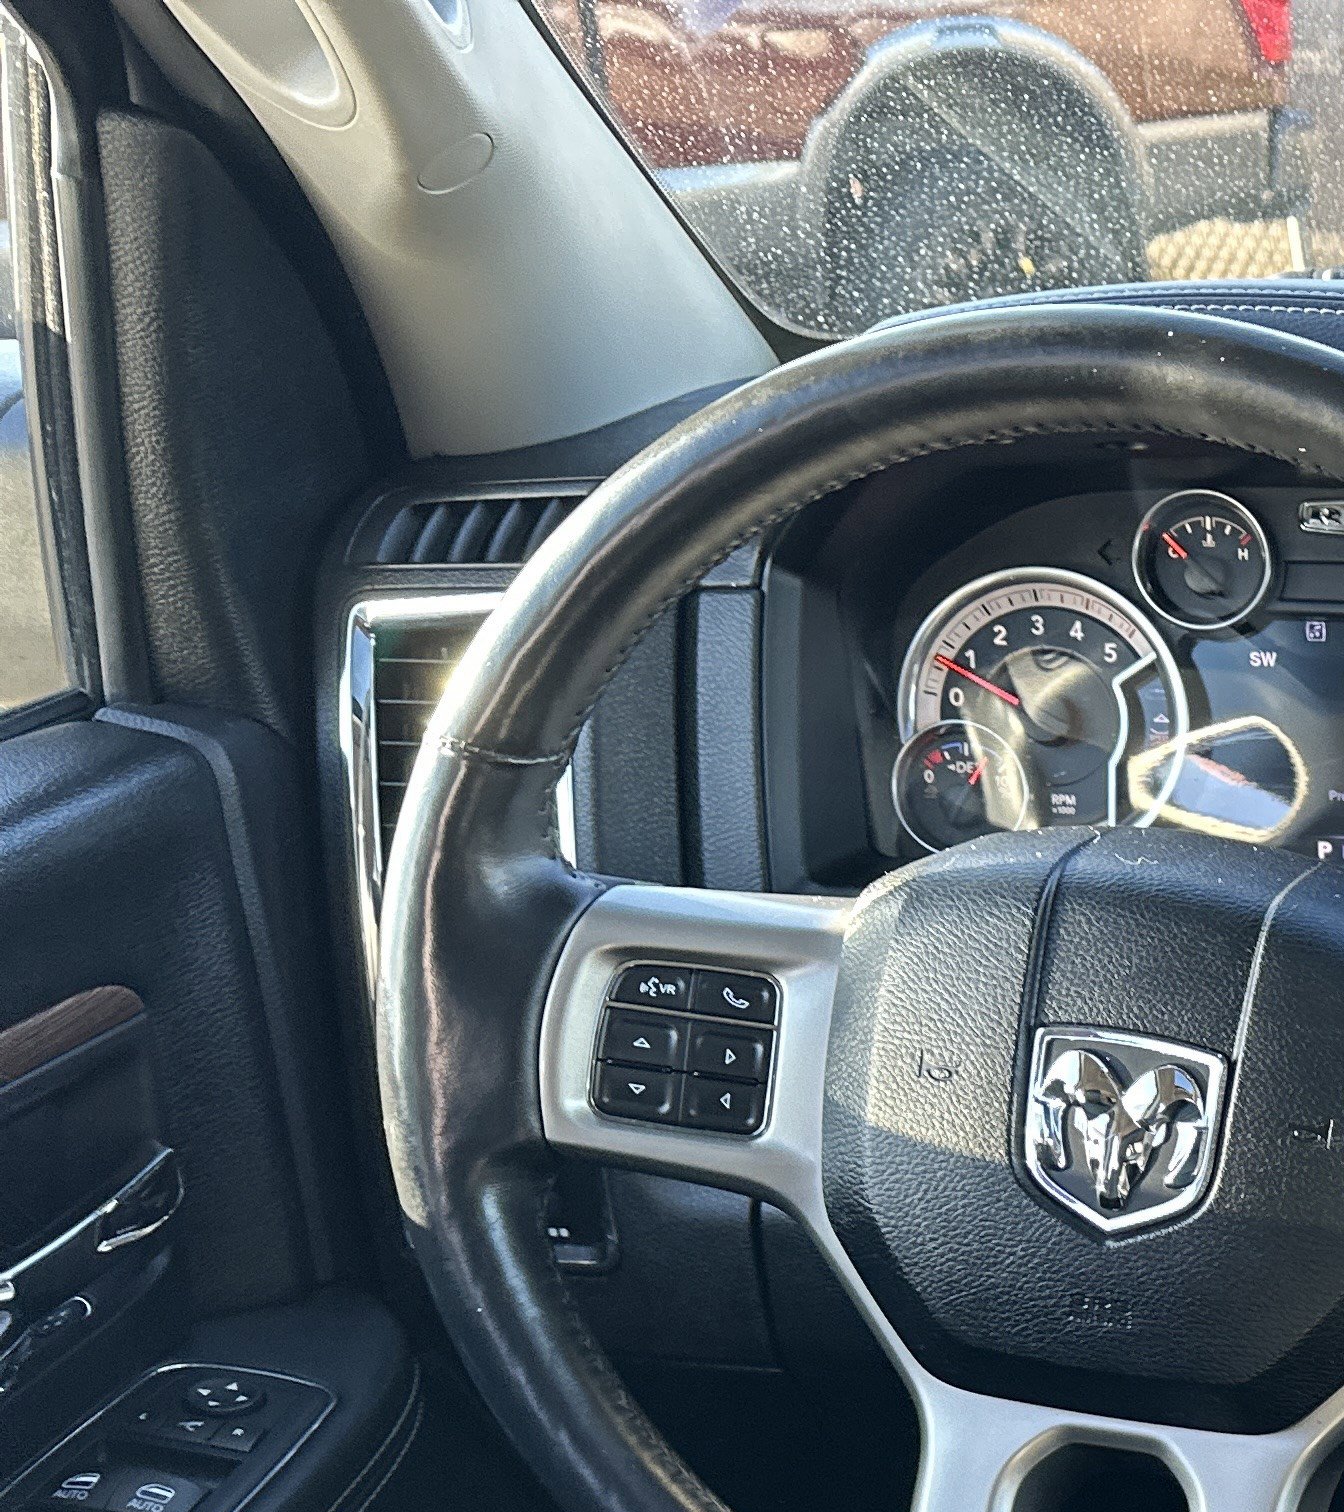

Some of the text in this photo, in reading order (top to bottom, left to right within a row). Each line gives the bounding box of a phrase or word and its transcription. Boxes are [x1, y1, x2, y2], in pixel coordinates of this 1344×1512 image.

[1237, 548, 1249, 561] H
[993, 625, 1008, 646] 2
[1030, 615, 1045, 636] 3
[1068, 620, 1085, 642] 4
[964, 649, 977, 669] 1
[1103, 642, 1118, 663] 5
[1249, 651, 1278, 668] SW
[948, 687, 965, 708] 0
[923, 769, 935, 784] 0
[1050, 793, 1077, 806] RPM
[1316, 840, 1334, 860] P
[659, 983, 677, 996] VR
[52, 1488, 89, 1501] AUTO
